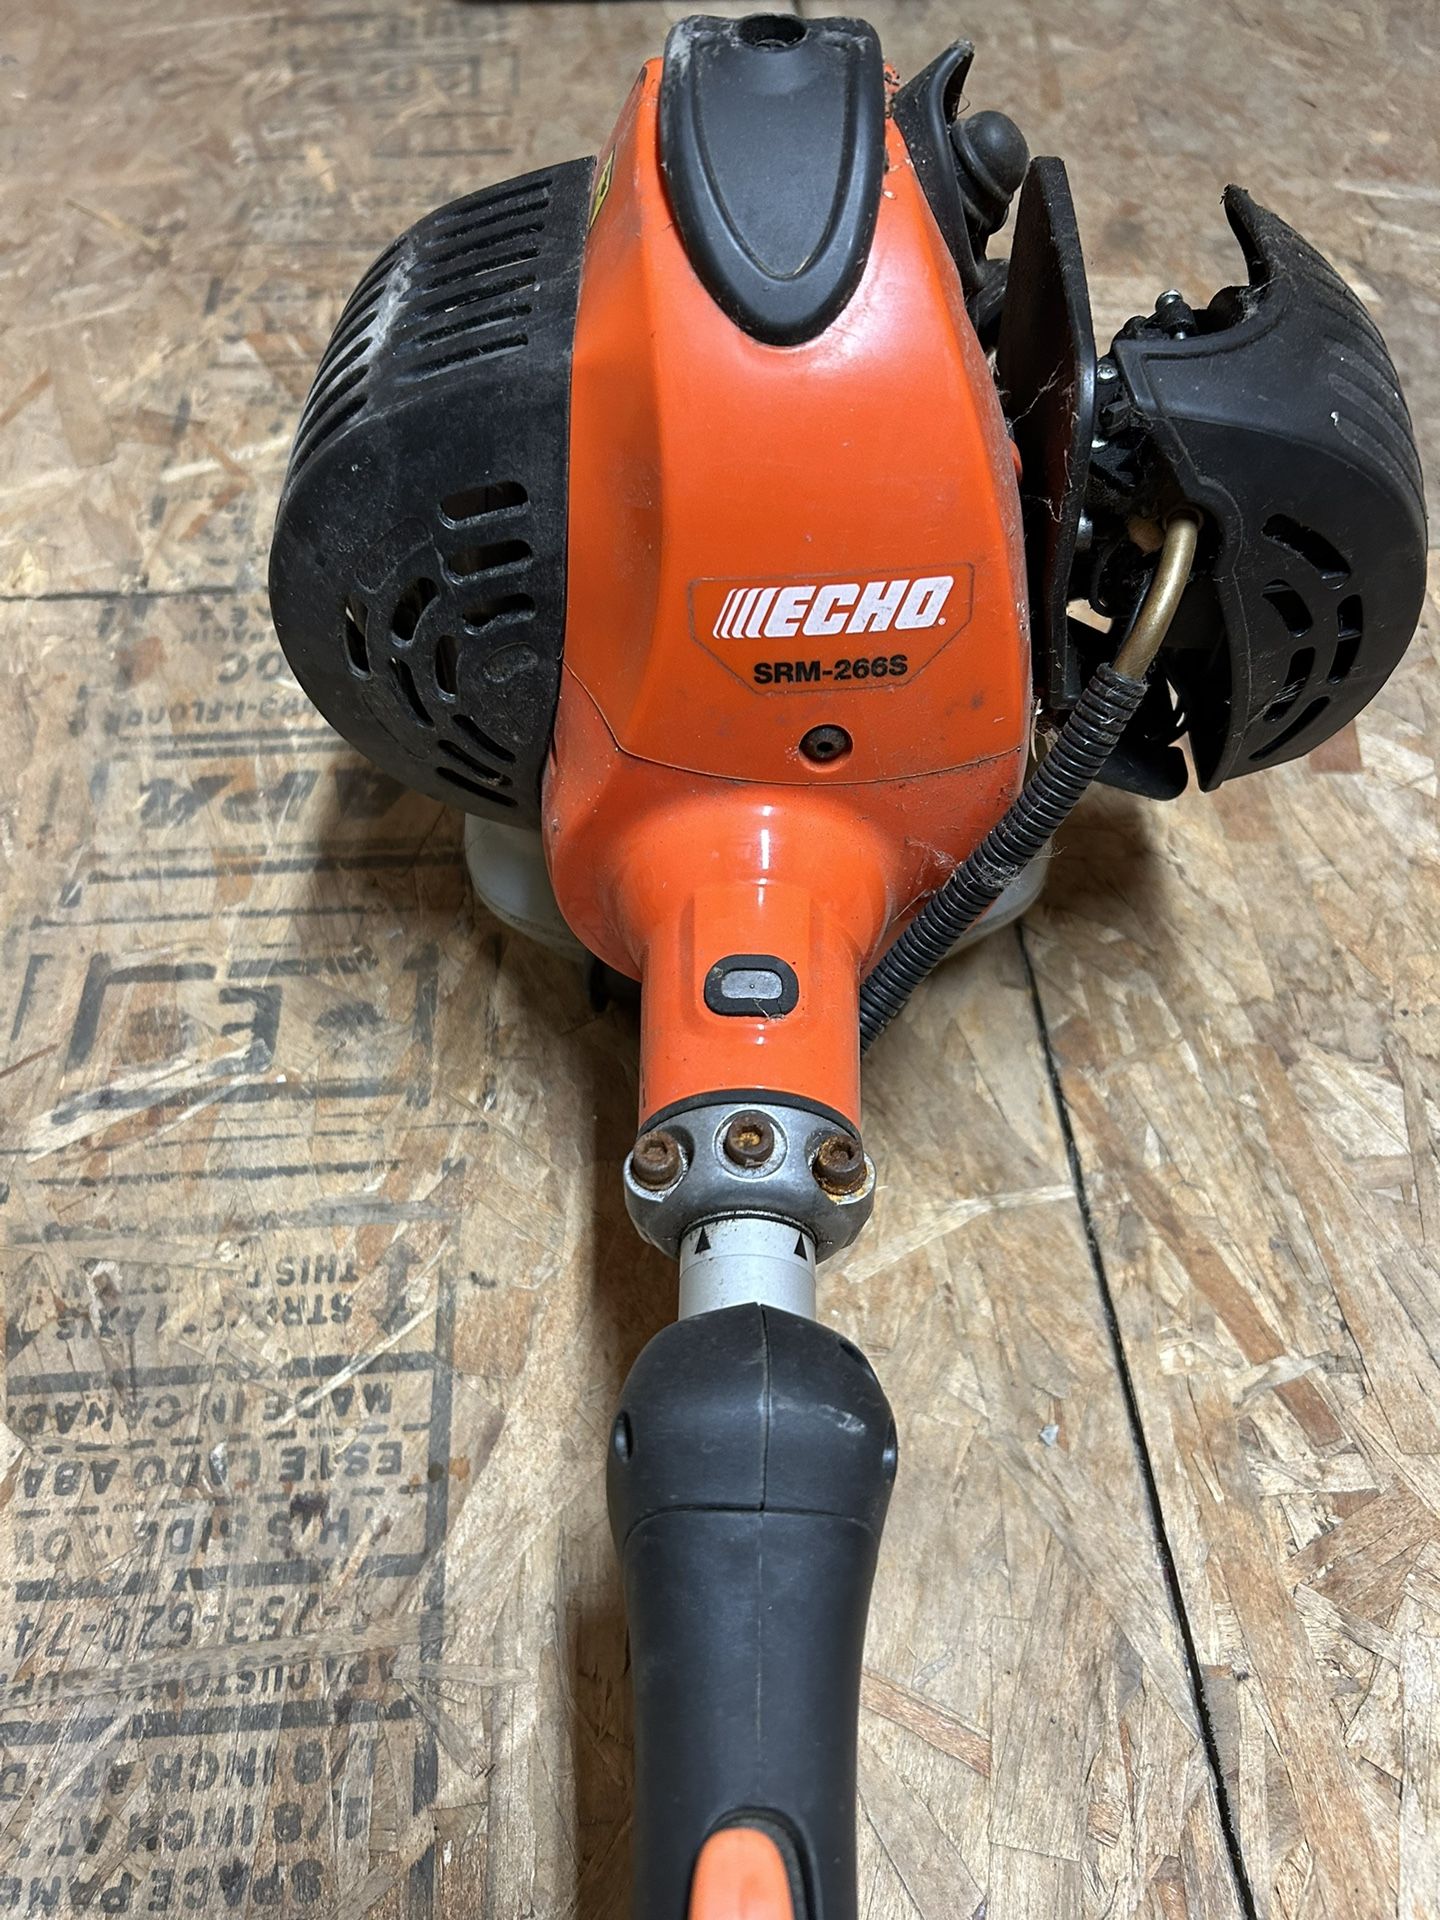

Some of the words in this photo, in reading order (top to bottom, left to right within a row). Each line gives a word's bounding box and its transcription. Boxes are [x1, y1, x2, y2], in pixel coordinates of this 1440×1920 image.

[753, 654, 908, 684] SRM-266S
[275, 1254, 358, 1287] THIS
[150, 1745, 275, 1794] INCH
